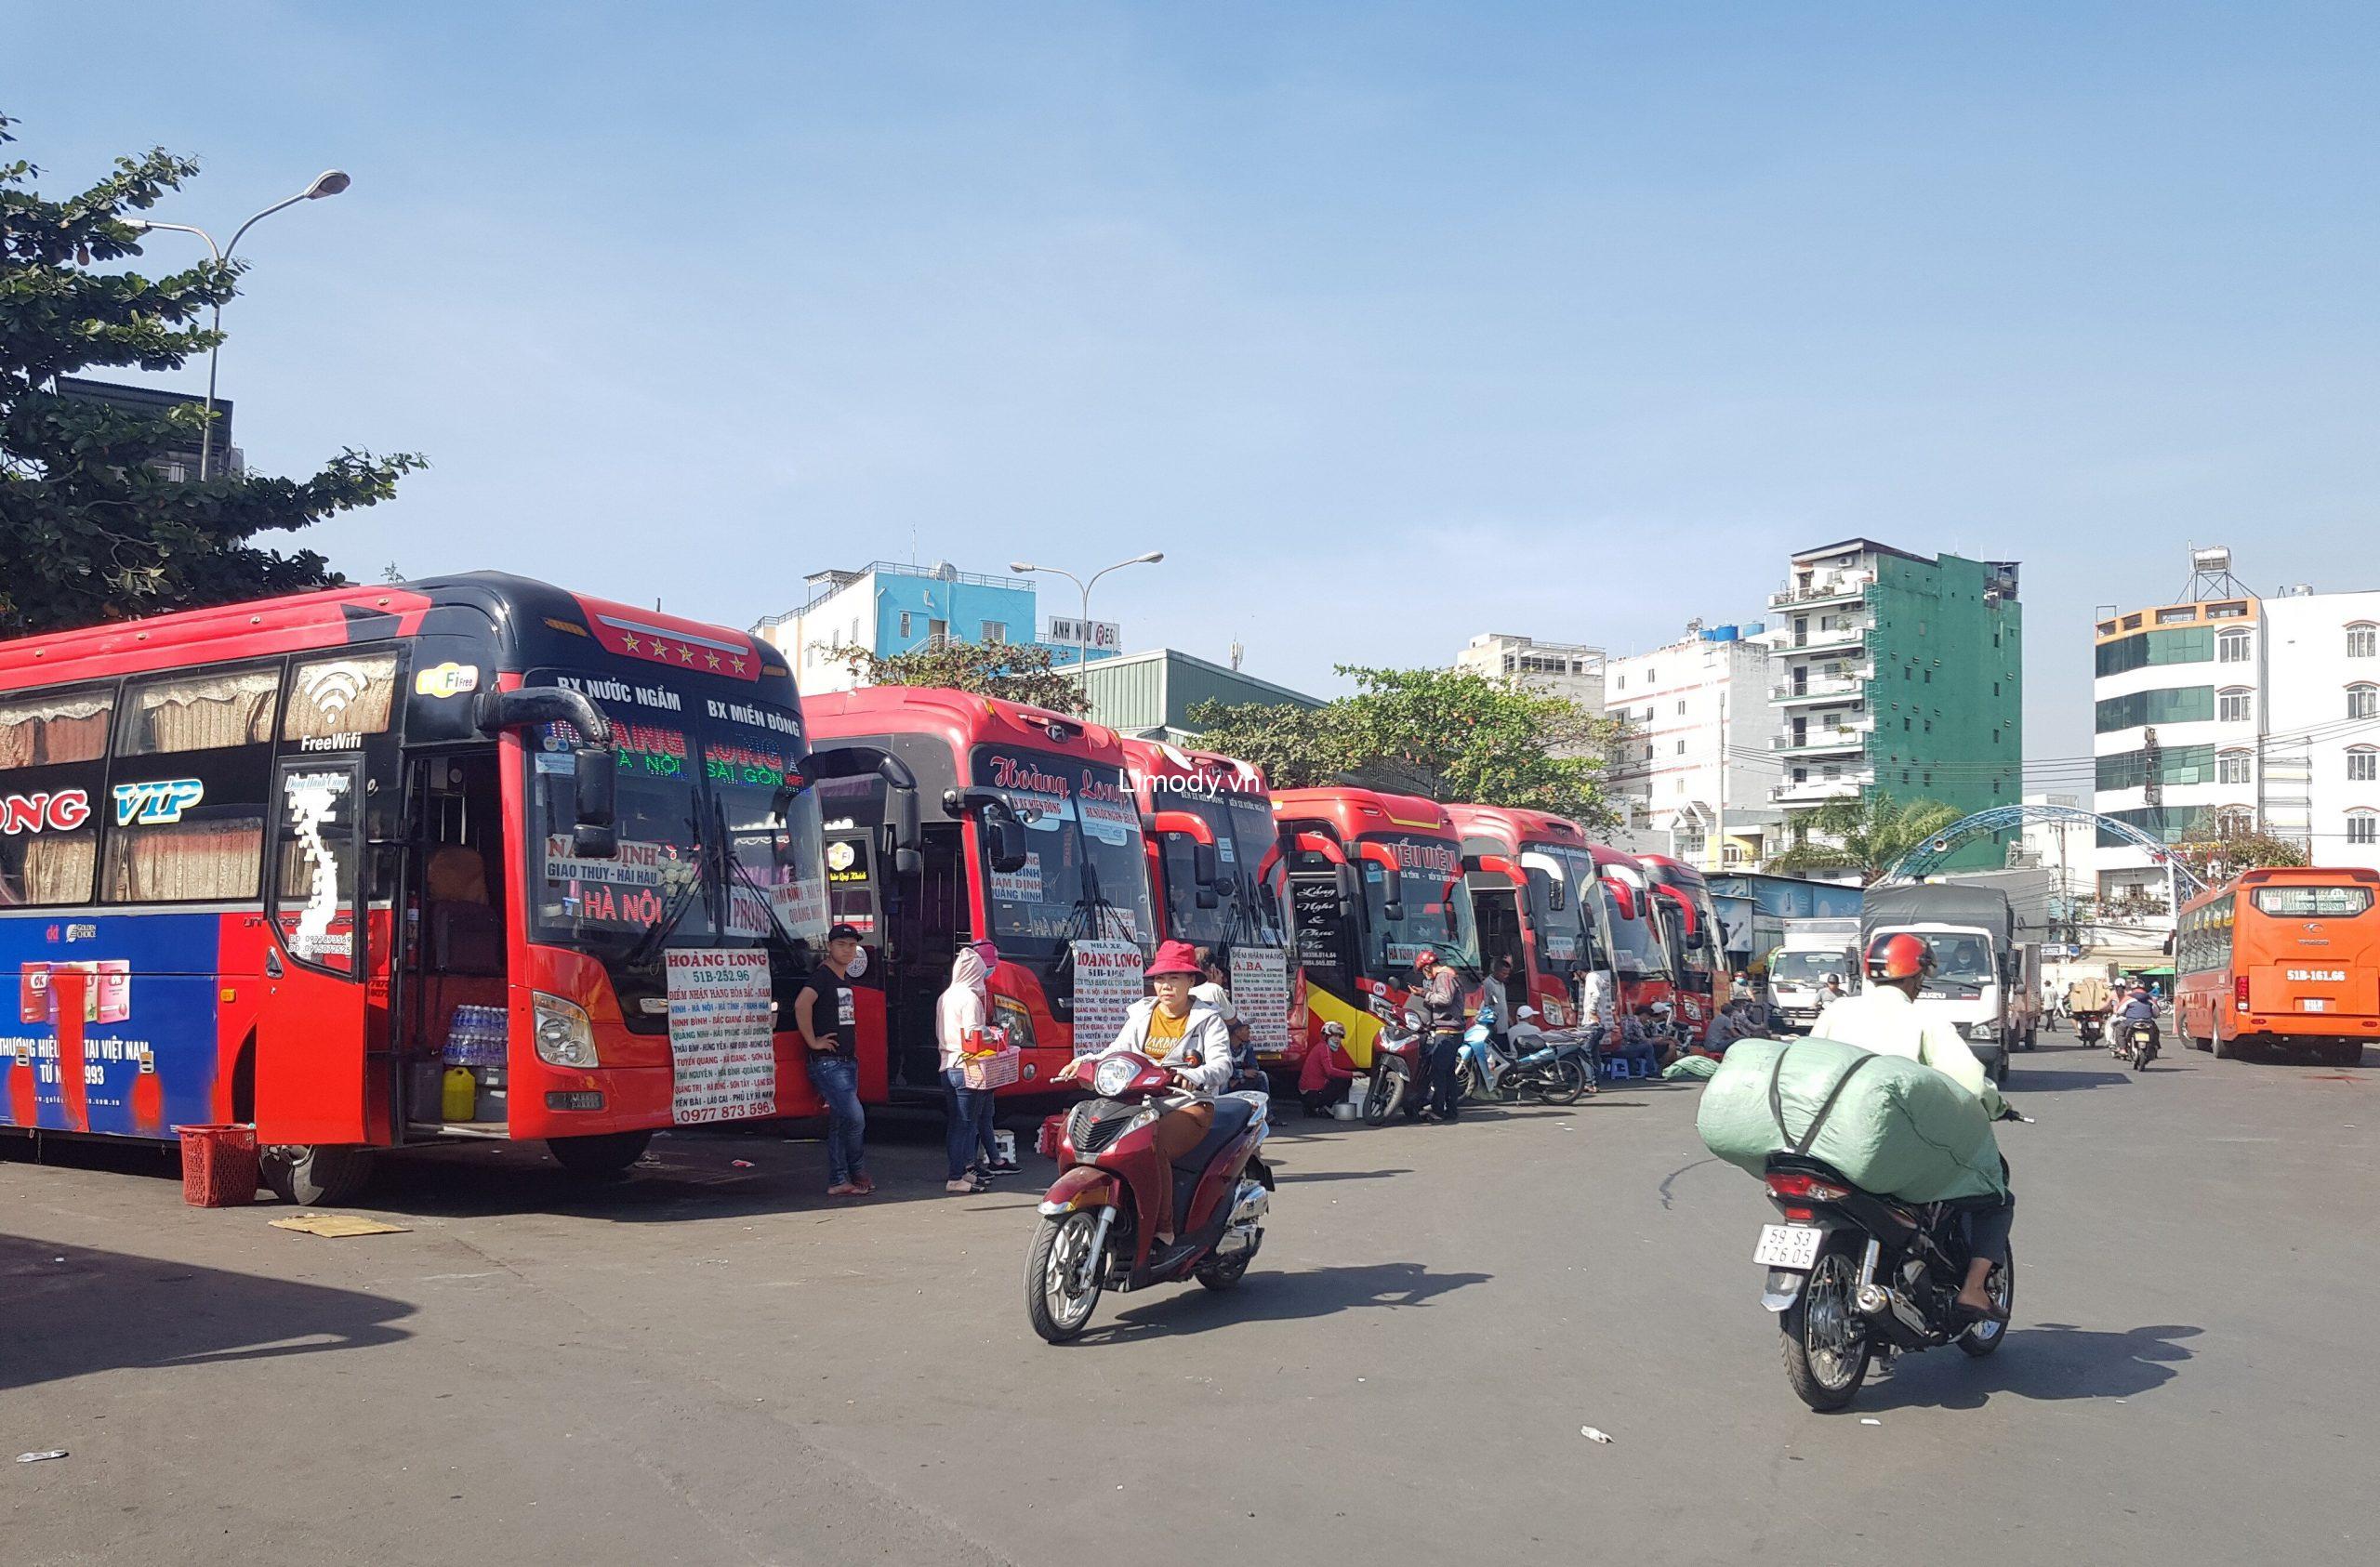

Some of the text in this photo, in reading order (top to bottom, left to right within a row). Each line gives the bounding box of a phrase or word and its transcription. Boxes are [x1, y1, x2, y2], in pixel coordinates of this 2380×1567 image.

[1052, 621, 1070, 639] ANH
[1076, 621, 1092, 641] NỮ
[586, 677, 631, 703] NƯỚC
[635, 685, 681, 712] NGẦM
[707, 700, 728, 719] BX
[768, 713, 800, 738] ĐÔNG
[300, 731, 362, 751] FreeWifi
[617, 749, 633, 770] À
[989, 756, 1128, 809] Hoàng Long
[0, 788, 90, 836] NG
[112, 778, 205, 827] VIP
[1421, 843, 1457, 874] VIỆN
[548, 863, 576, 877] GIAO
[581, 863, 609, 880] THỦY
[1021, 890, 1041, 902] NINH
[584, 886, 662, 928] HÀ NỘI
[1307, 915, 1326, 924] &
[668, 952, 767, 968] HOÀNG LONG
[1115, 954, 1142, 968] LONG
[693, 970, 749, 982] 51B-252.96
[709, 987, 729, 998] HÀNG
[670, 1005, 686, 1014] VINH
[693, 1003, 700, 1012] HÀ
[671, 1019, 688, 1027] NINH
[691, 1016, 707, 1026] BÌNH
[725, 1015, 741, 1023] GIANG
[102, 1035, 124, 1063] VIỆT
[696, 1056, 719, 1066] QUANG
[764, 1051, 773, 1060] LA
[85, 1066, 104, 1085] 993
[681, 1101, 770, 1123] 0977 873 596
